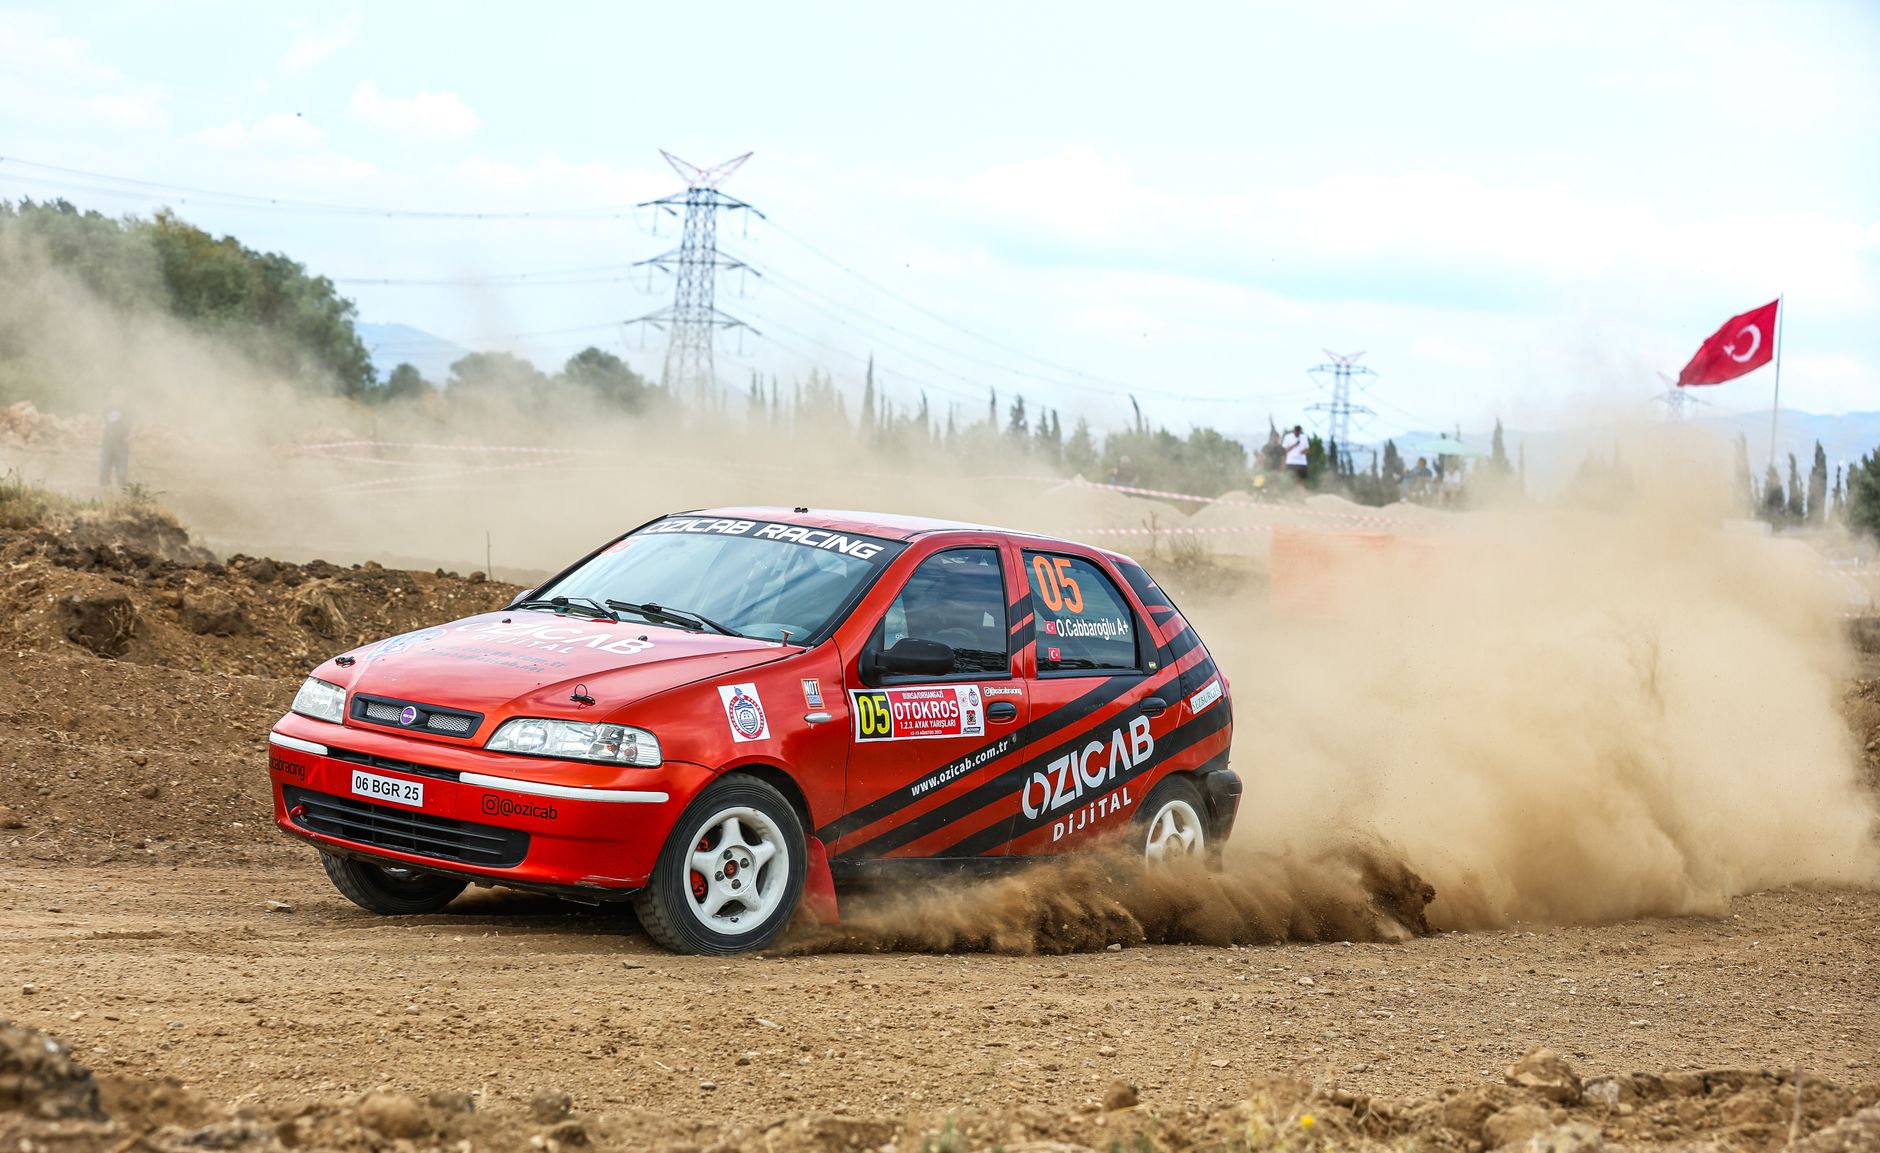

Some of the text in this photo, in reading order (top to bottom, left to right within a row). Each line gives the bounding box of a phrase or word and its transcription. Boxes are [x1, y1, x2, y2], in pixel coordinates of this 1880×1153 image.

[643, 517, 885, 560] OZICAB RACING
[1033, 556, 1084, 613] 05
[455, 622, 656, 655] OZICAB
[858, 695, 891, 735] 05
[894, 700, 959, 720] OTOKROS
[915, 720, 929, 728] AYAK
[911, 739, 1008, 796] www.ozicab.com.tr
[1022, 715, 1154, 820] OZICAB
[356, 776, 419, 801] 06 BGR 25
[500, 798, 558, 820] @ozicab
